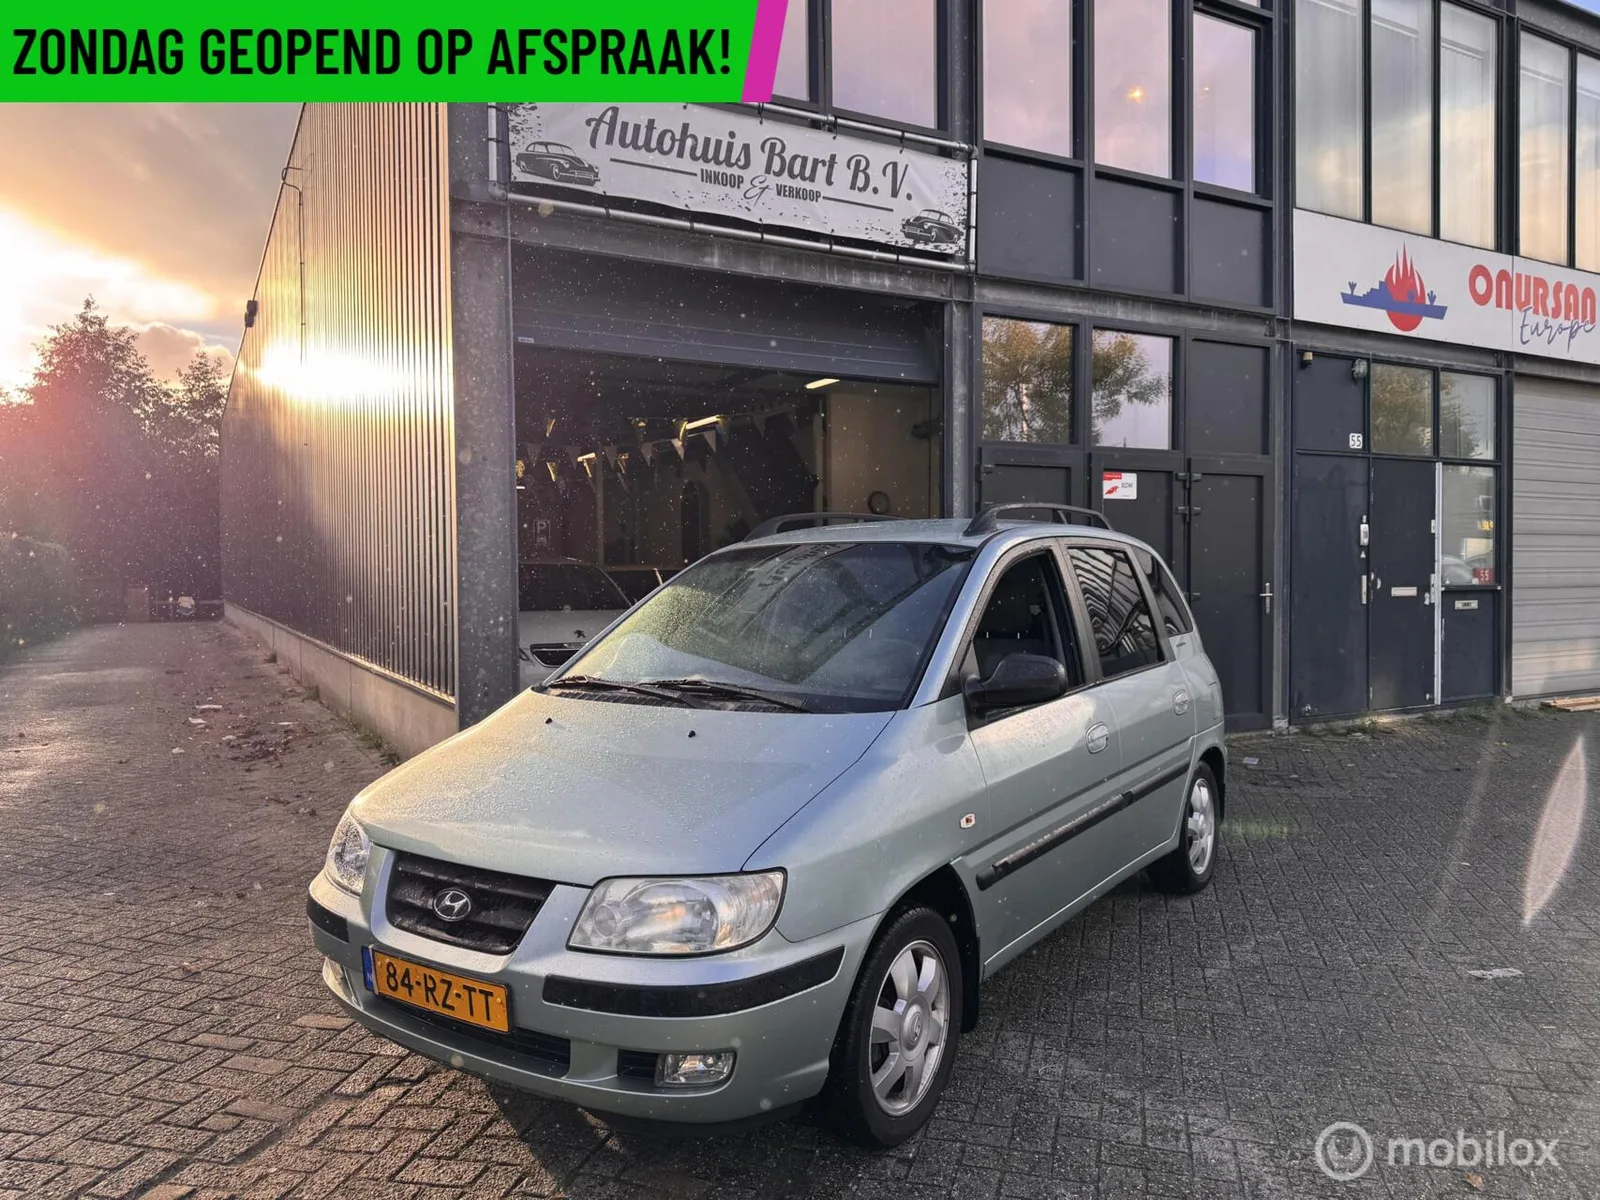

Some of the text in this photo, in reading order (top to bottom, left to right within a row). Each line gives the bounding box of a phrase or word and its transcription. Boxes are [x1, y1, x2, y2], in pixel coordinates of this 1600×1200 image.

[585, 105, 913, 202] Autohuis Bart B.V.
[700, 168, 822, 208] INKOOP & VERKOOP
[1468, 264, 1597, 325] ONURSAN
[1519, 306, 1597, 353] Europe
[1351, 434, 1362, 448] 55
[537, 521, 547, 534] P
[1480, 570, 1489, 581] 55
[386, 961, 495, 1021] 84-RZ-TT
